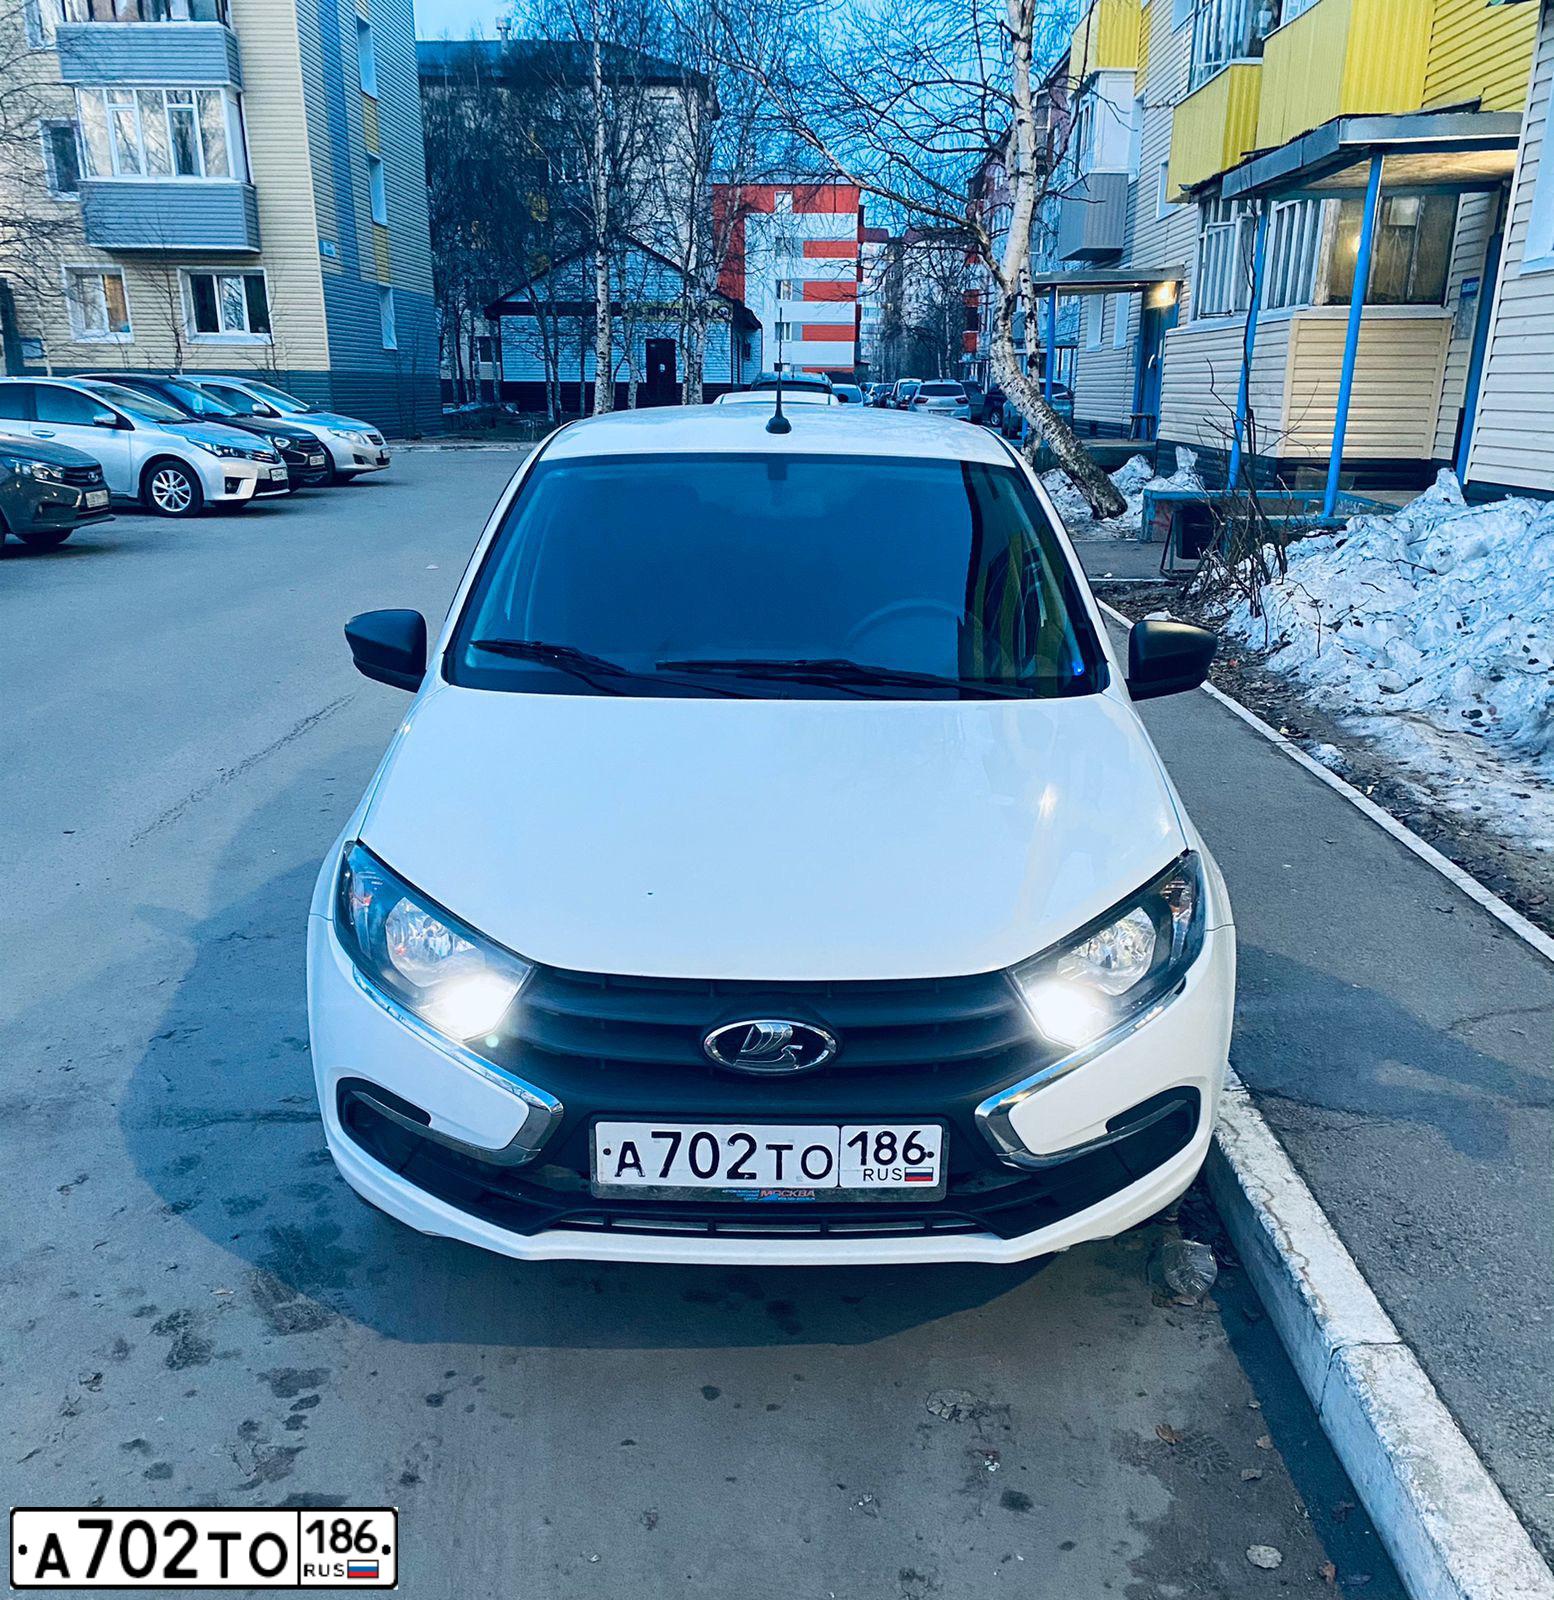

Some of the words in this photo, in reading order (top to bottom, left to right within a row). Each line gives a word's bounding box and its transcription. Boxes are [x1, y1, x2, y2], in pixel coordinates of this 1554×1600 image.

[614, 1131, 833, 1181] А702ТО
[847, 1131, 927, 1166] 186
[863, 1168, 903, 1181] RUS
